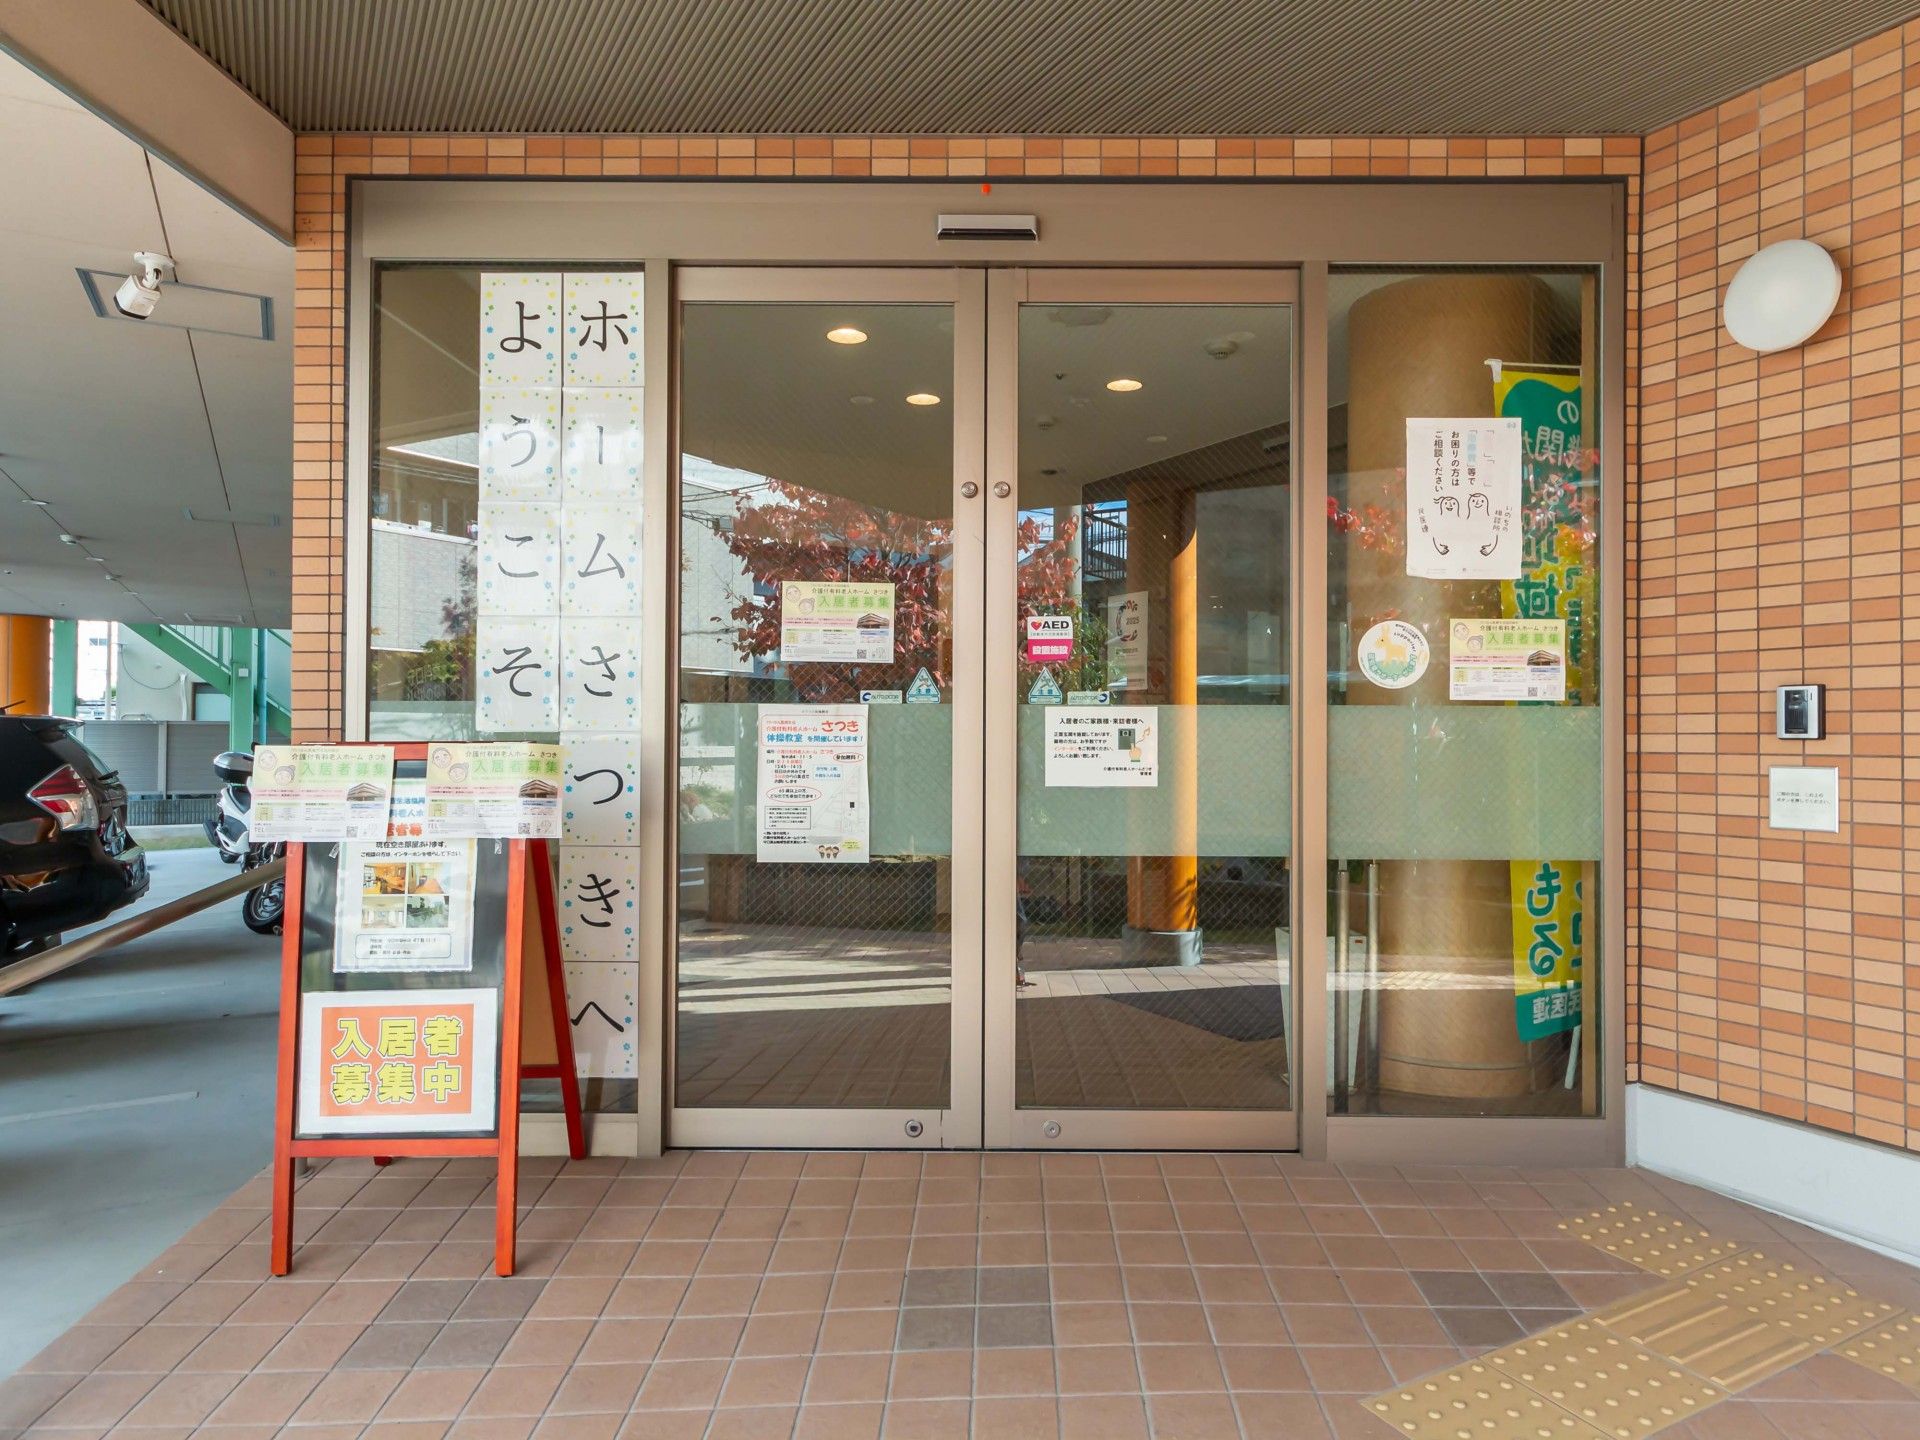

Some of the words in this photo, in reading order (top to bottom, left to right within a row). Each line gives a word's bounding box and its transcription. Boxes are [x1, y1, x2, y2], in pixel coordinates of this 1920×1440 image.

[1433, 430, 1443, 493] ご相談ください
[1450, 430, 1460, 487] お困りの方は
[491, 300, 542, 698] ようこそ
[811, 587, 870, 595] 介護付有料老人ホーム
[818, 595, 890, 609] 入居者募集
[1042, 620, 1069, 629] AED
[1487, 632, 1559, 645] 入居者募集
[570, 299, 629, 1033] ホームさつきへ
[821, 720, 859, 732] さつき
[766, 733, 803, 743] 体操教室
[291, 753, 364, 761] 介護付有料老人ホーム
[368, 753, 386, 761] さつき
[465, 749, 536, 758] 介護付有料老人ホーム
[540, 750, 558, 758] さつき
[302, 761, 386, 776] 入居者募集
[474, 758, 559, 775] 入居者募集
[331, 1015, 462, 1059] 入居者
[330, 1060, 463, 1106] 募集中
